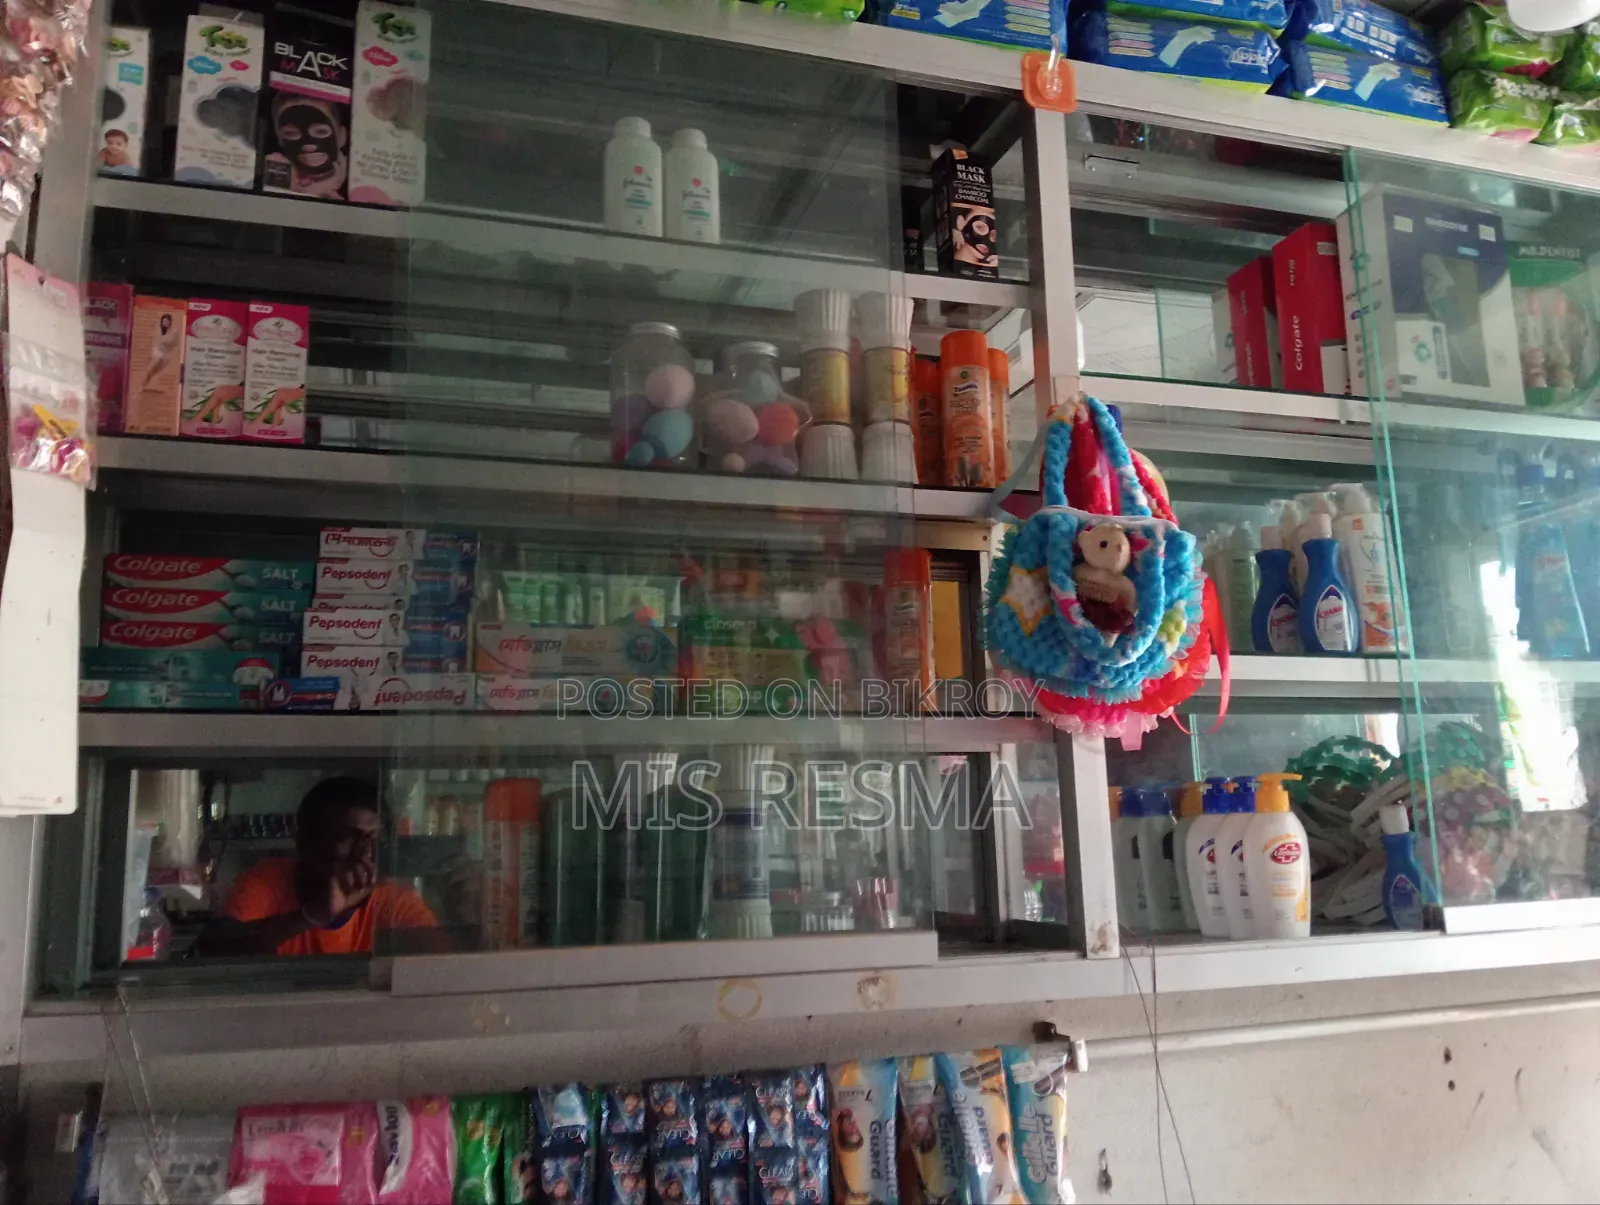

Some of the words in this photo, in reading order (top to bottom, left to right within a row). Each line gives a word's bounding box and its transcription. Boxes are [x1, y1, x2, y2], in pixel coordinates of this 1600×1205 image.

[274, 42, 349, 77] BLACK
[956, 163, 985, 174] BLACK
[957, 171, 986, 183] MASK
[1291, 314, 1304, 371] Colgate
[113, 554, 201, 576] Colgate
[262, 567, 298, 581] SALT
[322, 565, 392, 581] Pepsodent
[111, 588, 199, 609] Colgate
[260, 599, 297, 612] SALT
[109, 620, 197, 642] Colgate
[258, 631, 296, 645] SALT
[309, 615, 383, 631] Pepsodent
[306, 654, 380, 670] Pepsodent
[373, 687, 467, 706] Pepsodent
[869, 1119, 883, 1181] Guard
[1018, 1103, 1047, 1184] Gillette
[1039, 1113, 1059, 1177] Guard
[712, 1148, 746, 1161] CLEAR
